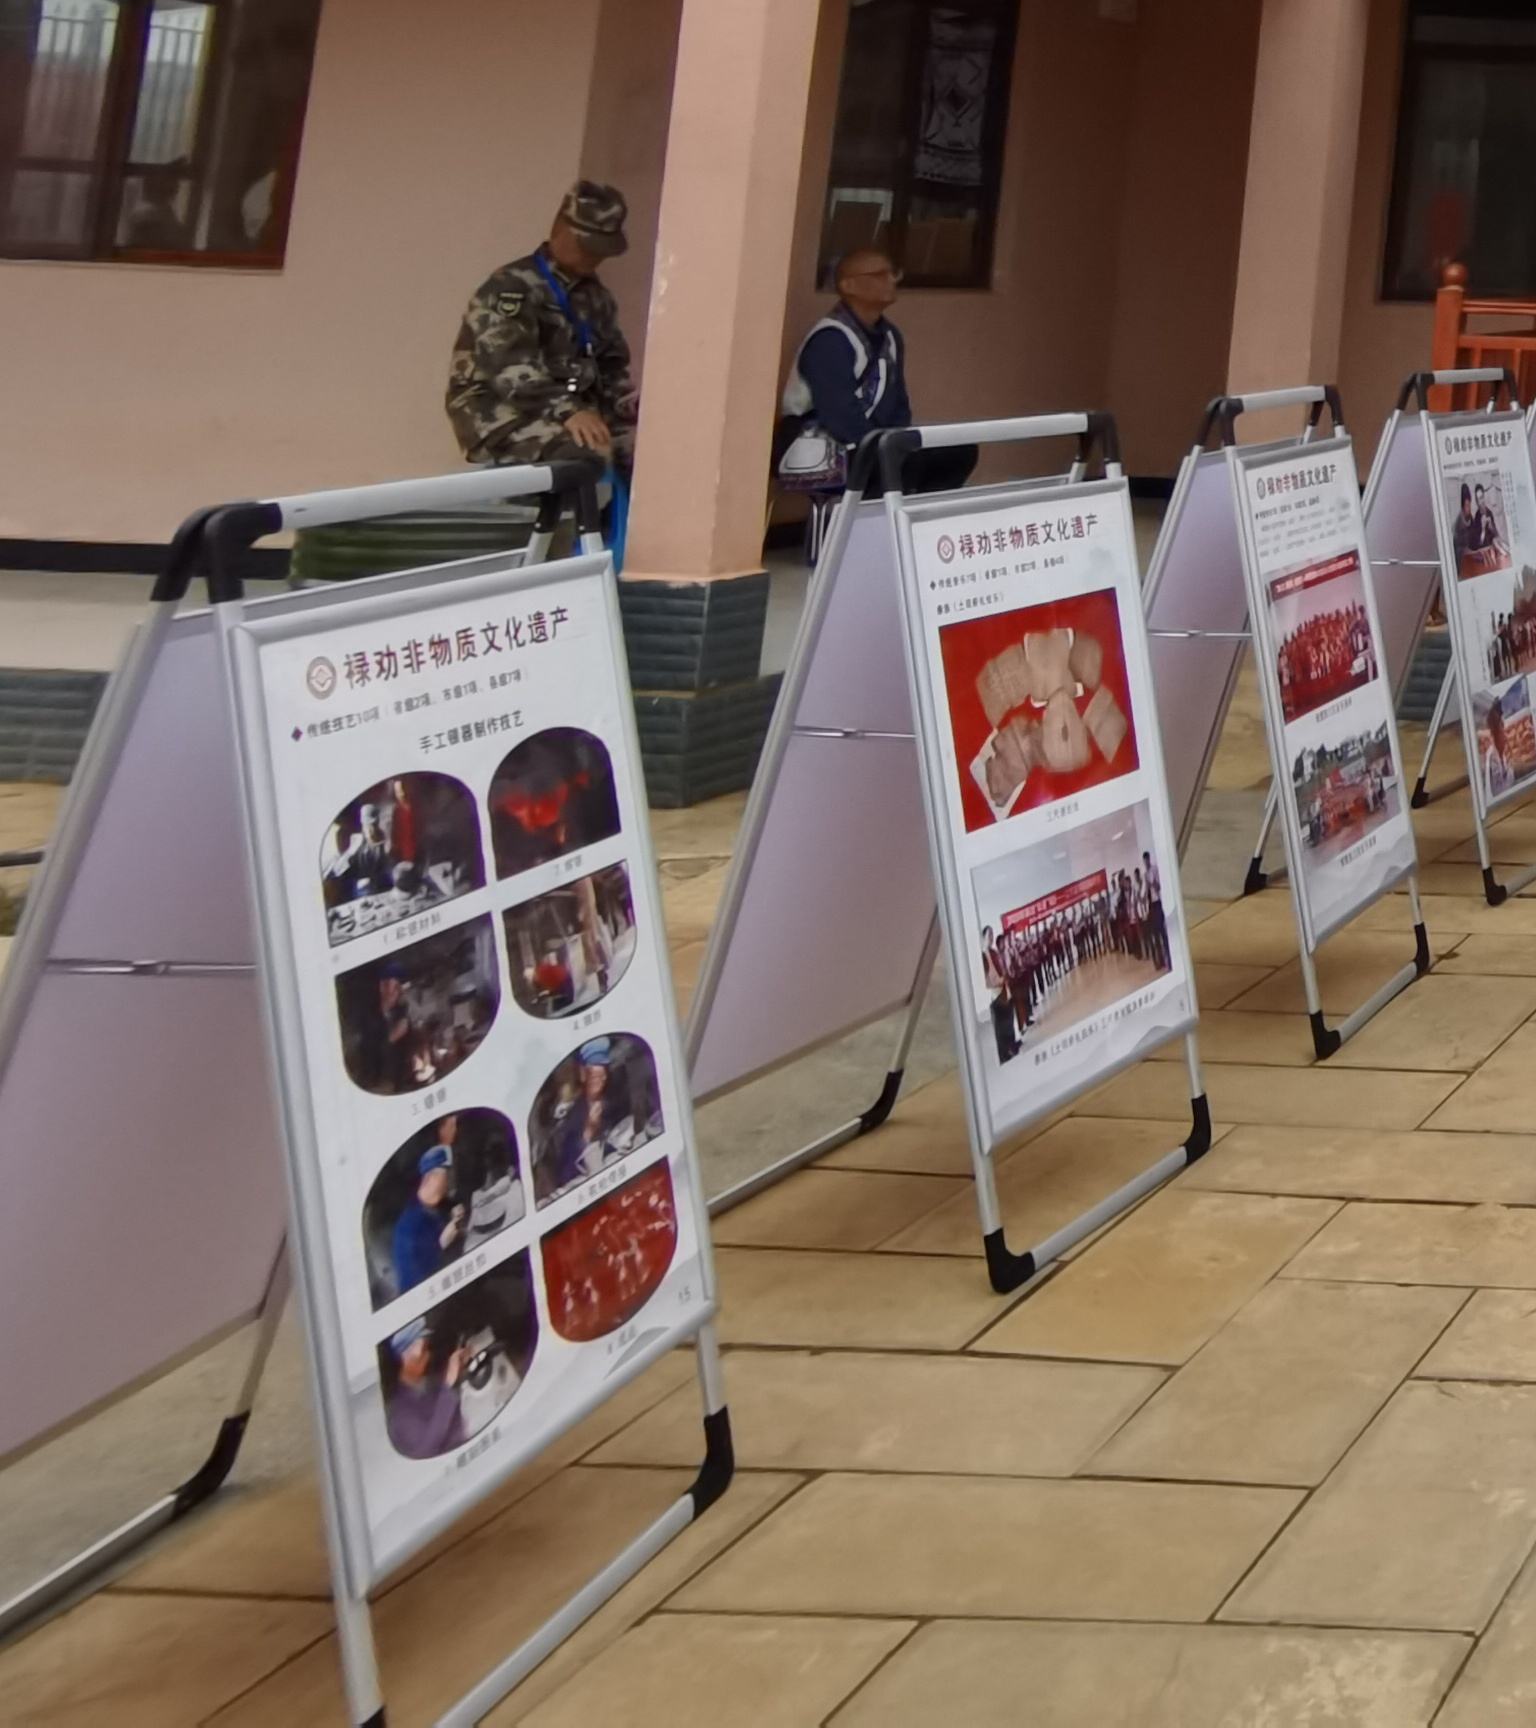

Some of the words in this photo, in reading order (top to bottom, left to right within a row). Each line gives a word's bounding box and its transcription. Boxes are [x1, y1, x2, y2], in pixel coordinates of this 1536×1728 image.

[959, 512, 1098, 560] 禄劝非物质文化遗产
[344, 605, 569, 690] 禄劝非物质文化遗产
